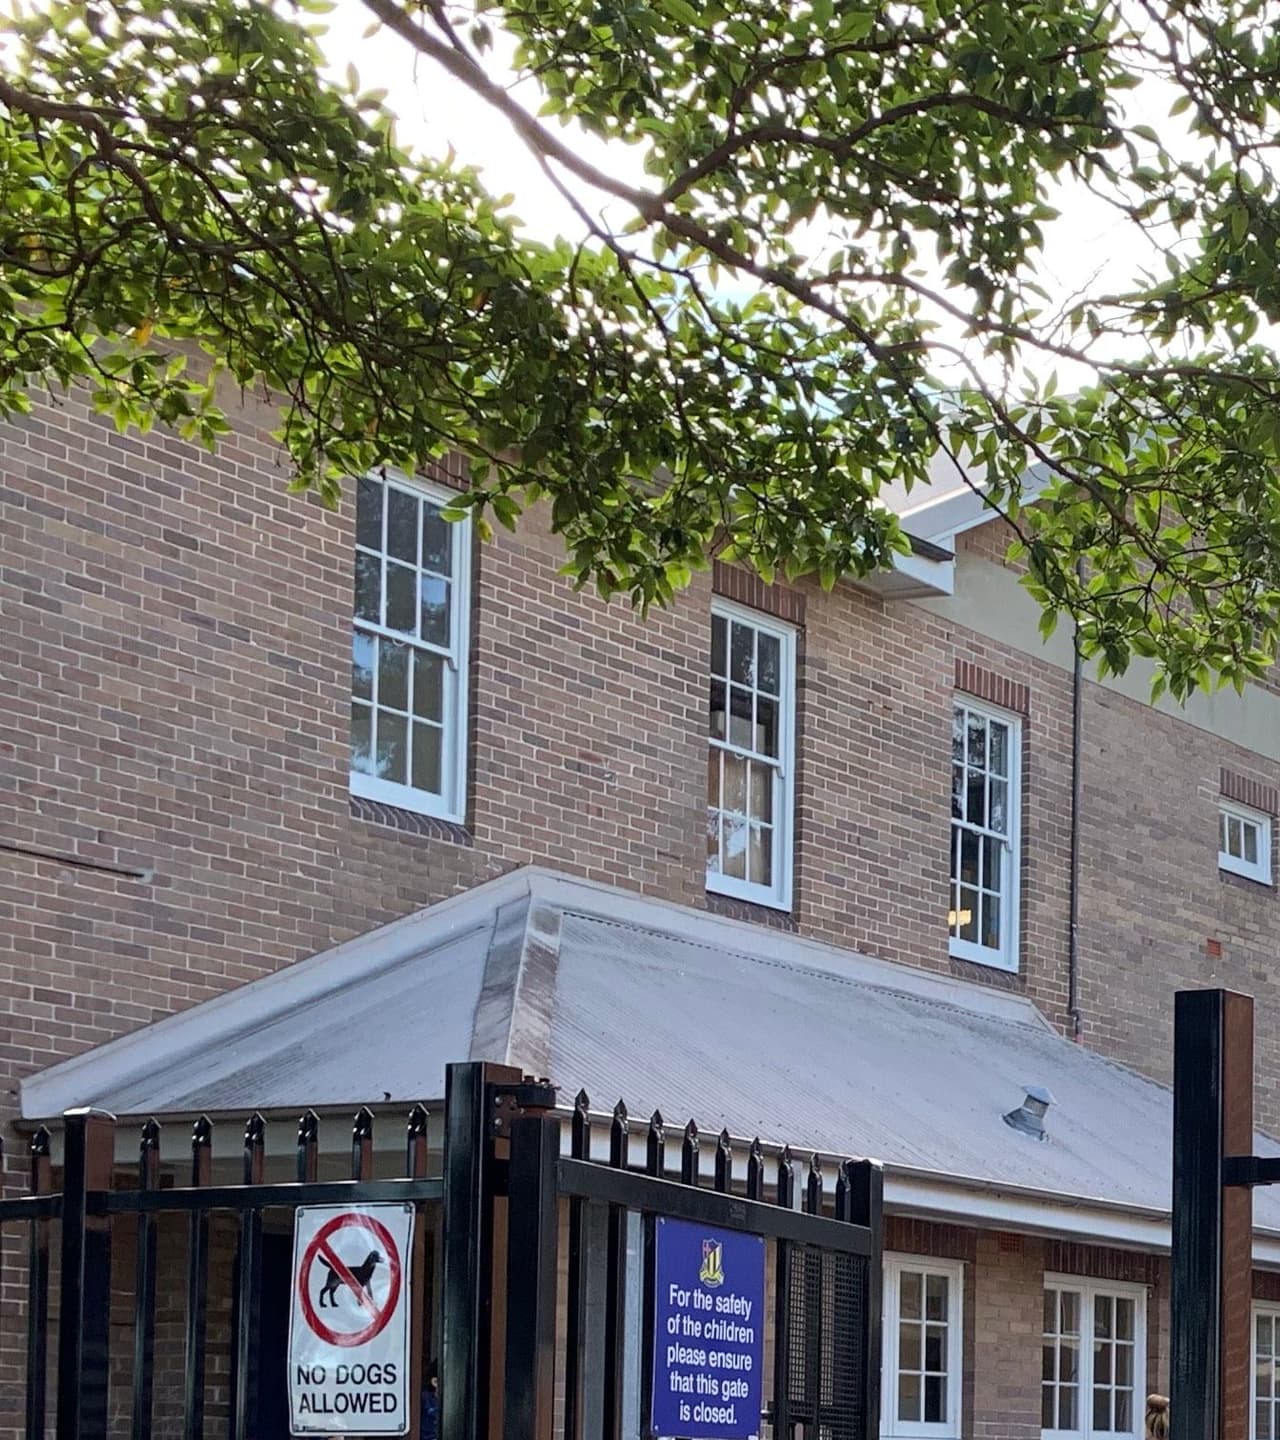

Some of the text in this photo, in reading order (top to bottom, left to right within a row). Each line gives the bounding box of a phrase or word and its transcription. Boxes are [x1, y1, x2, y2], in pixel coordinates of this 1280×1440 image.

[669, 1284, 752, 1321] For the safety
[667, 1313, 754, 1345] of the children
[667, 1342, 752, 1372] please ensure
[297, 1363, 397, 1385] NO DOGS
[669, 1371, 749, 1401] that this gate
[298, 1392, 398, 1414] ALLOWED
[679, 1399, 738, 1425] is closed.
